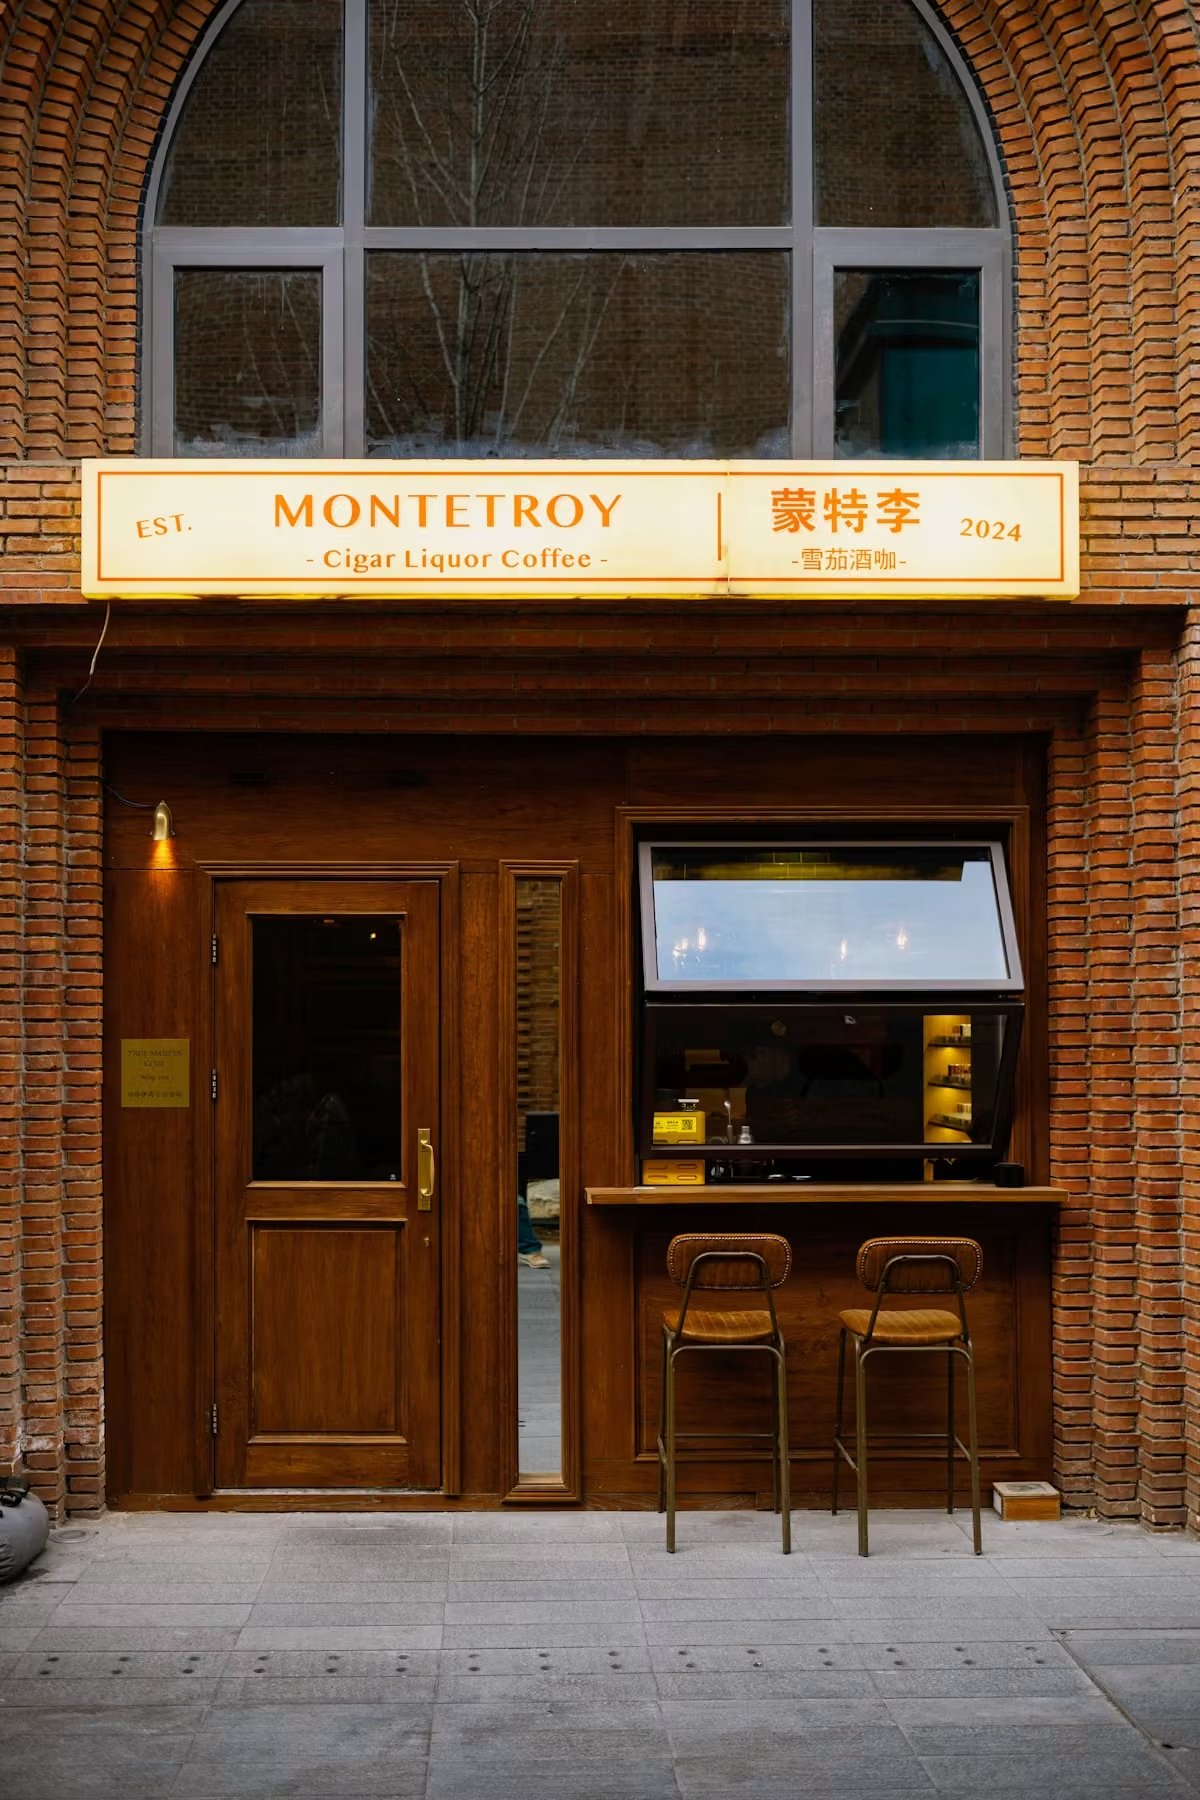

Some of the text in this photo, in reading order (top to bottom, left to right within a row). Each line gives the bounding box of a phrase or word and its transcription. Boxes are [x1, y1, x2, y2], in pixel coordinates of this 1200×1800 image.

[274, 494, 622, 528] MONTETROY
[770, 487, 920, 535] 蒙特李
[136, 514, 192, 539] EST.
[960, 518, 1022, 542] 2024
[323, 548, 396, 573] Cigar
[405, 548, 492, 573] Liquor
[501, 548, 591, 568] Coffee
